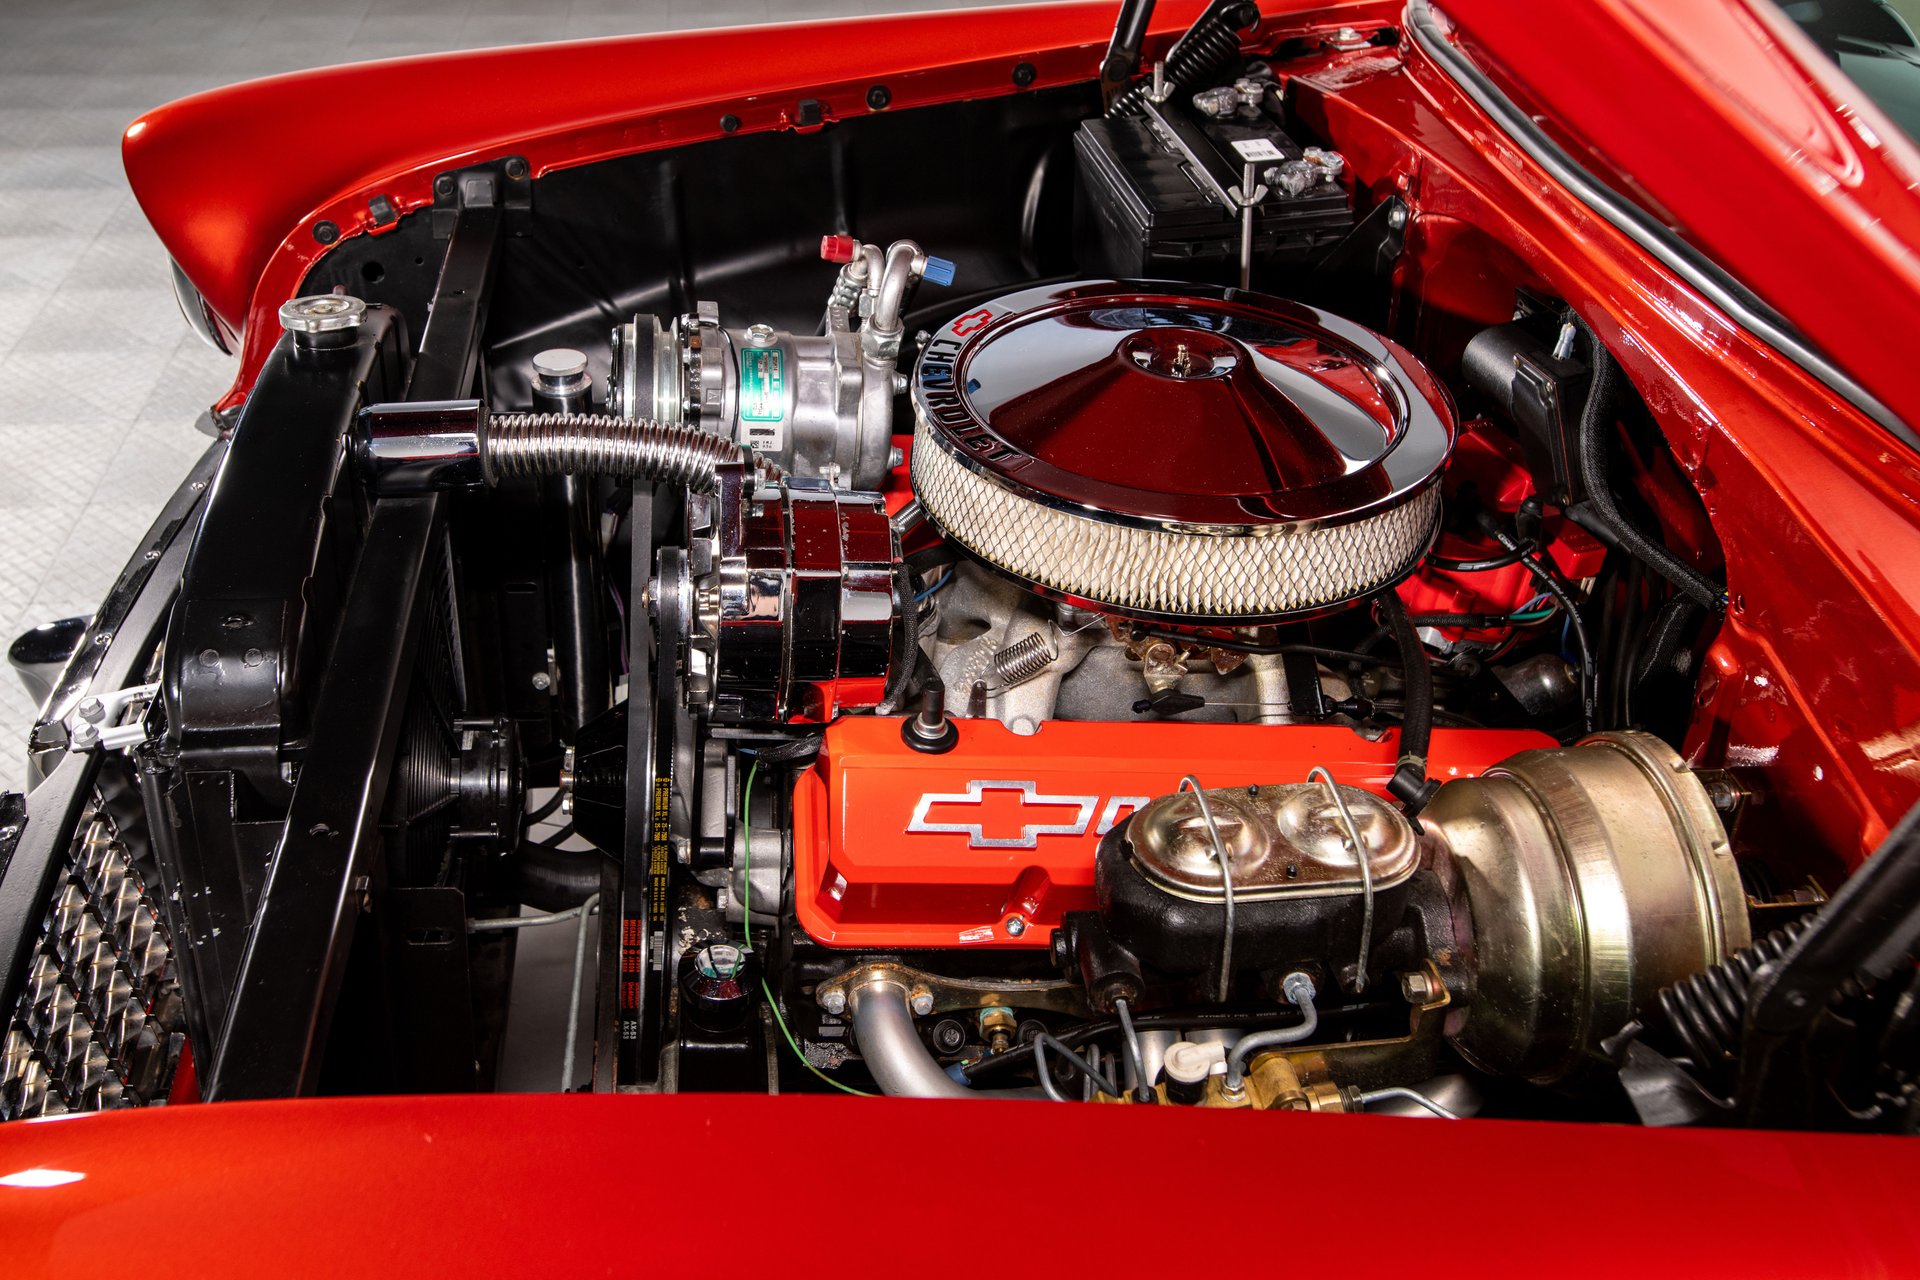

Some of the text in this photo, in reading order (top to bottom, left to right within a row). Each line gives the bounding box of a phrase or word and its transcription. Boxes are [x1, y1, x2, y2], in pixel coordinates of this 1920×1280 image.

[920, 339, 1023, 462] CHEVROLET
[1497, 533, 1517, 551] MSD
[1585, 698, 1593, 717] MSD
